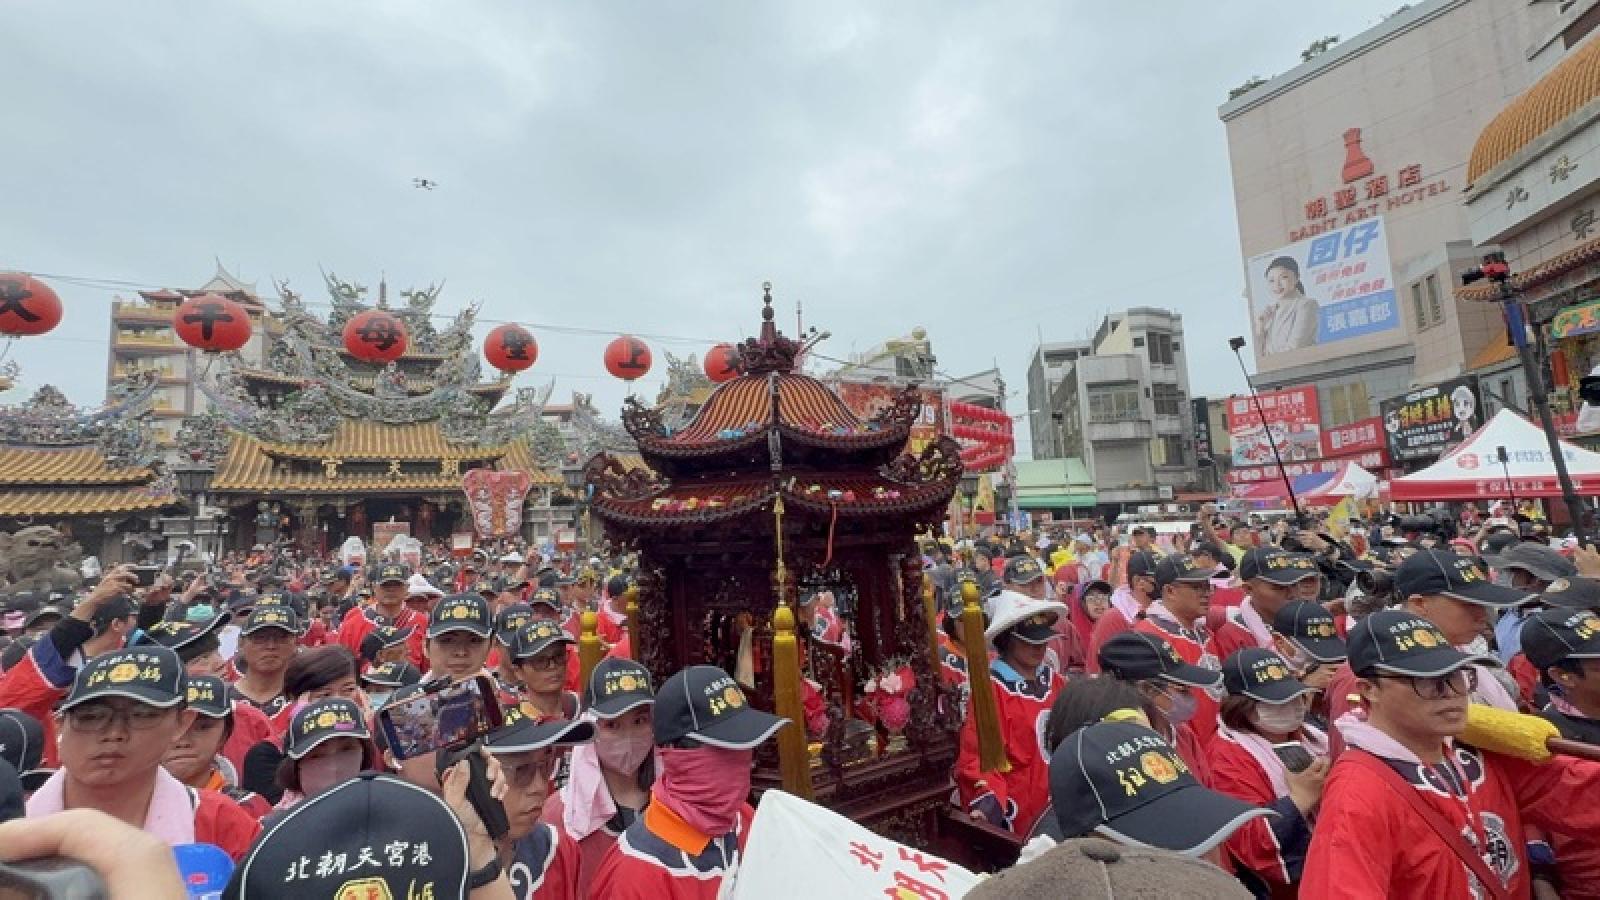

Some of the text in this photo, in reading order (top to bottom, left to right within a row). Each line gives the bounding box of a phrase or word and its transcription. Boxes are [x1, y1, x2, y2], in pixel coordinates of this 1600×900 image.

[1345, 203, 1379, 224] ART
[1387, 179, 1451, 210] HOTEL
[356, 317, 402, 351] 母
[617, 338, 648, 369] 上
